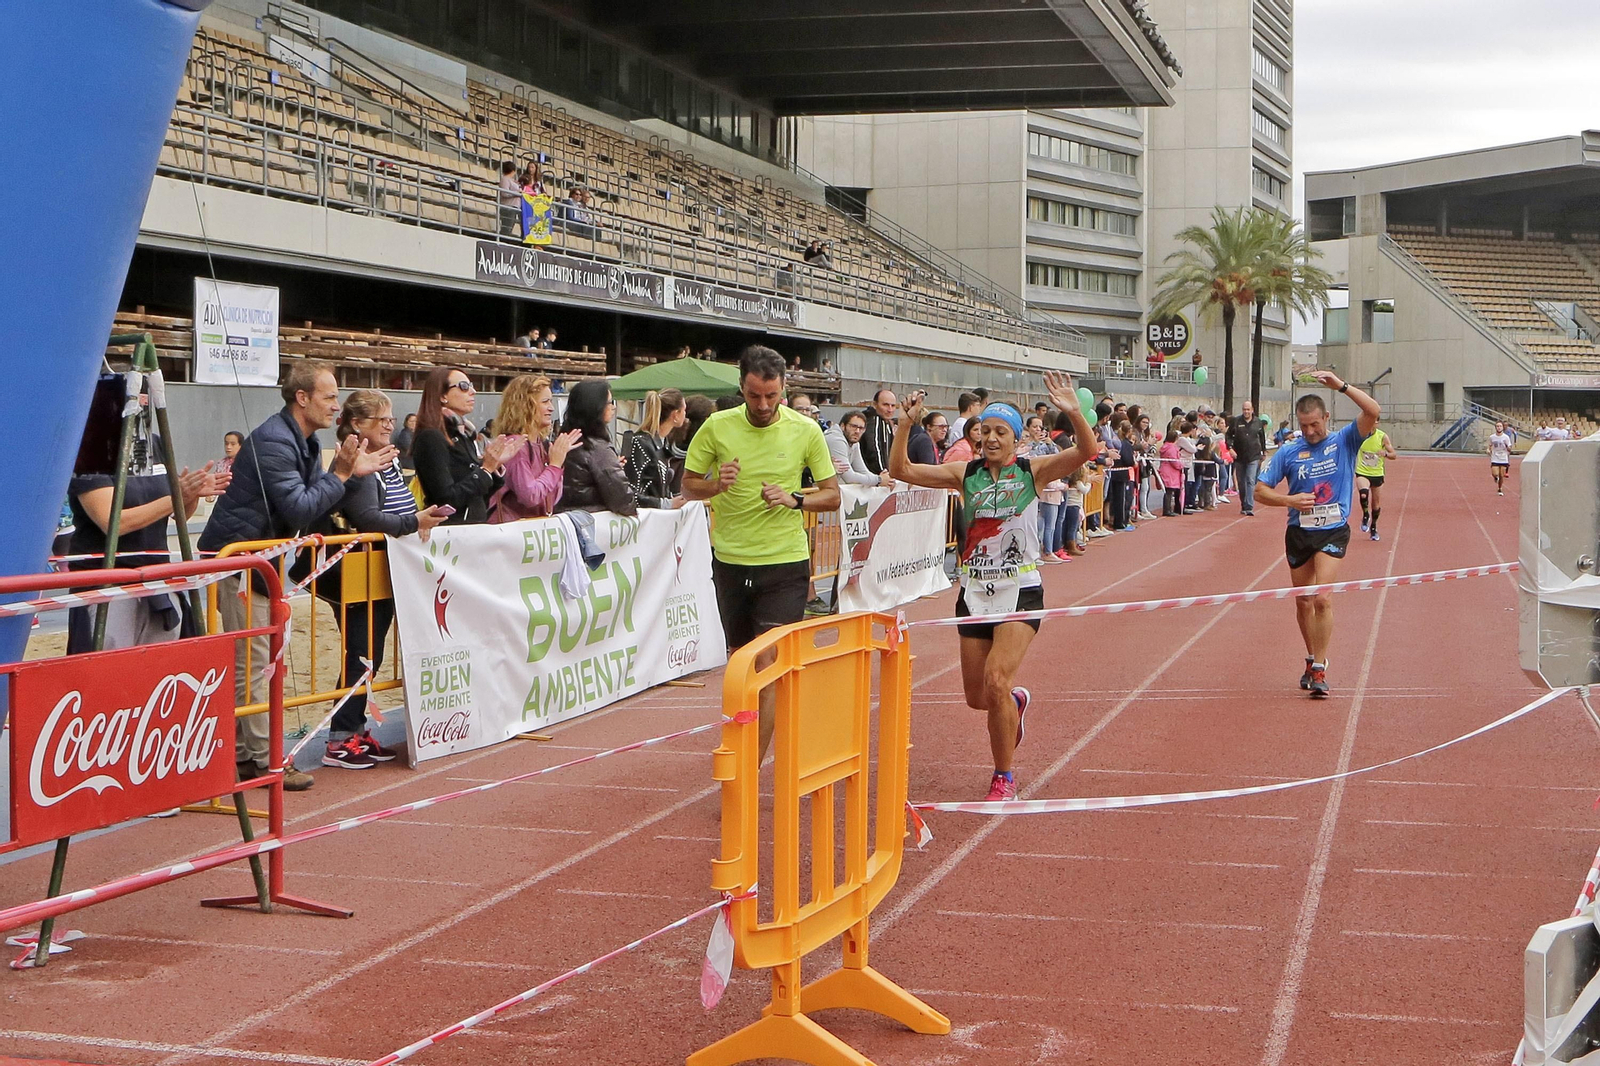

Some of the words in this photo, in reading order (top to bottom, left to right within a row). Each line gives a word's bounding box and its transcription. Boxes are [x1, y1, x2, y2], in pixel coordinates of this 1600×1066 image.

[538, 262, 573, 284] ALIMENTOS
[574, 269, 582, 285] DE
[583, 271, 607, 289] CALIDAD
[609, 517, 641, 550] CON
[1313, 516, 1327, 526] 27
[682, 592, 696, 602] CON
[985, 582, 996, 597] 8
[519, 556, 642, 664] BUEN
[665, 602, 699, 629] BUEN
[667, 624, 700, 641] AMBIENTE
[421, 652, 454, 668] EVENTOS
[454, 649, 470, 662] CON
[420, 662, 471, 696] BUEN
[521, 644, 638, 723] AMBIENTE
[419, 690, 471, 714] AMBIENTE
[29, 665, 228, 807] Coca-Cola
[417, 709, 472, 749] Coca-Cola
